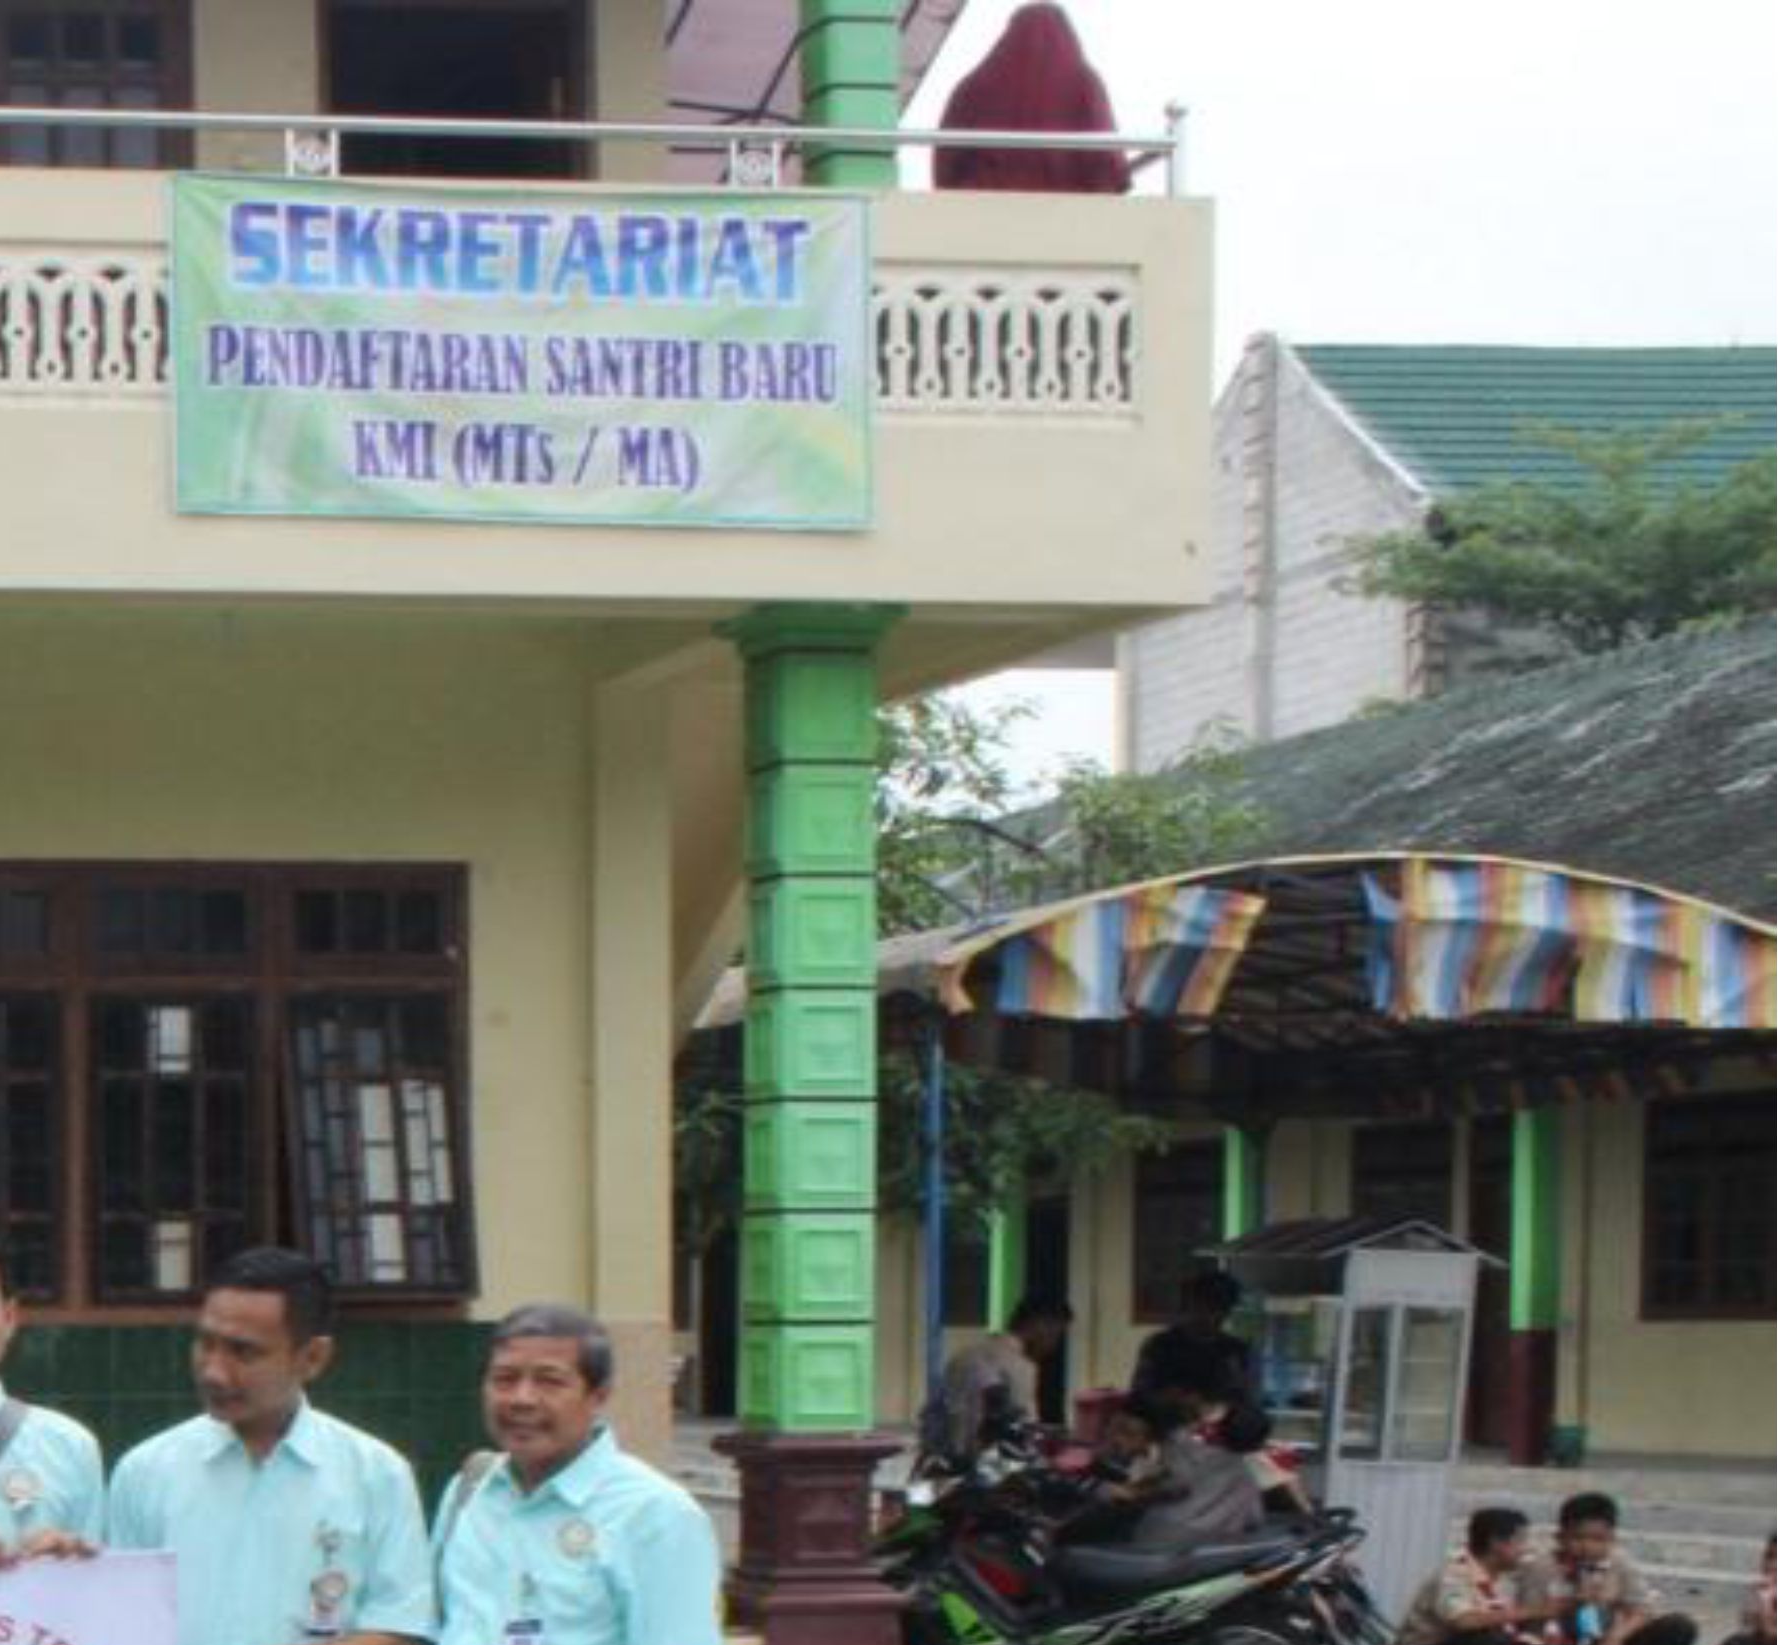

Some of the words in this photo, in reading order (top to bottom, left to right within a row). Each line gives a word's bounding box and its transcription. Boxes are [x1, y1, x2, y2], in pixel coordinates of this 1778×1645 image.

[229, 201, 810, 300] SEKRETARIAT
[207, 325, 528, 394] PENDAFTARAN
[546, 336, 700, 400] SANTRI
[719, 342, 838, 403] BARU
[353, 421, 437, 481] KMI
[618, 427, 699, 492] MA)
